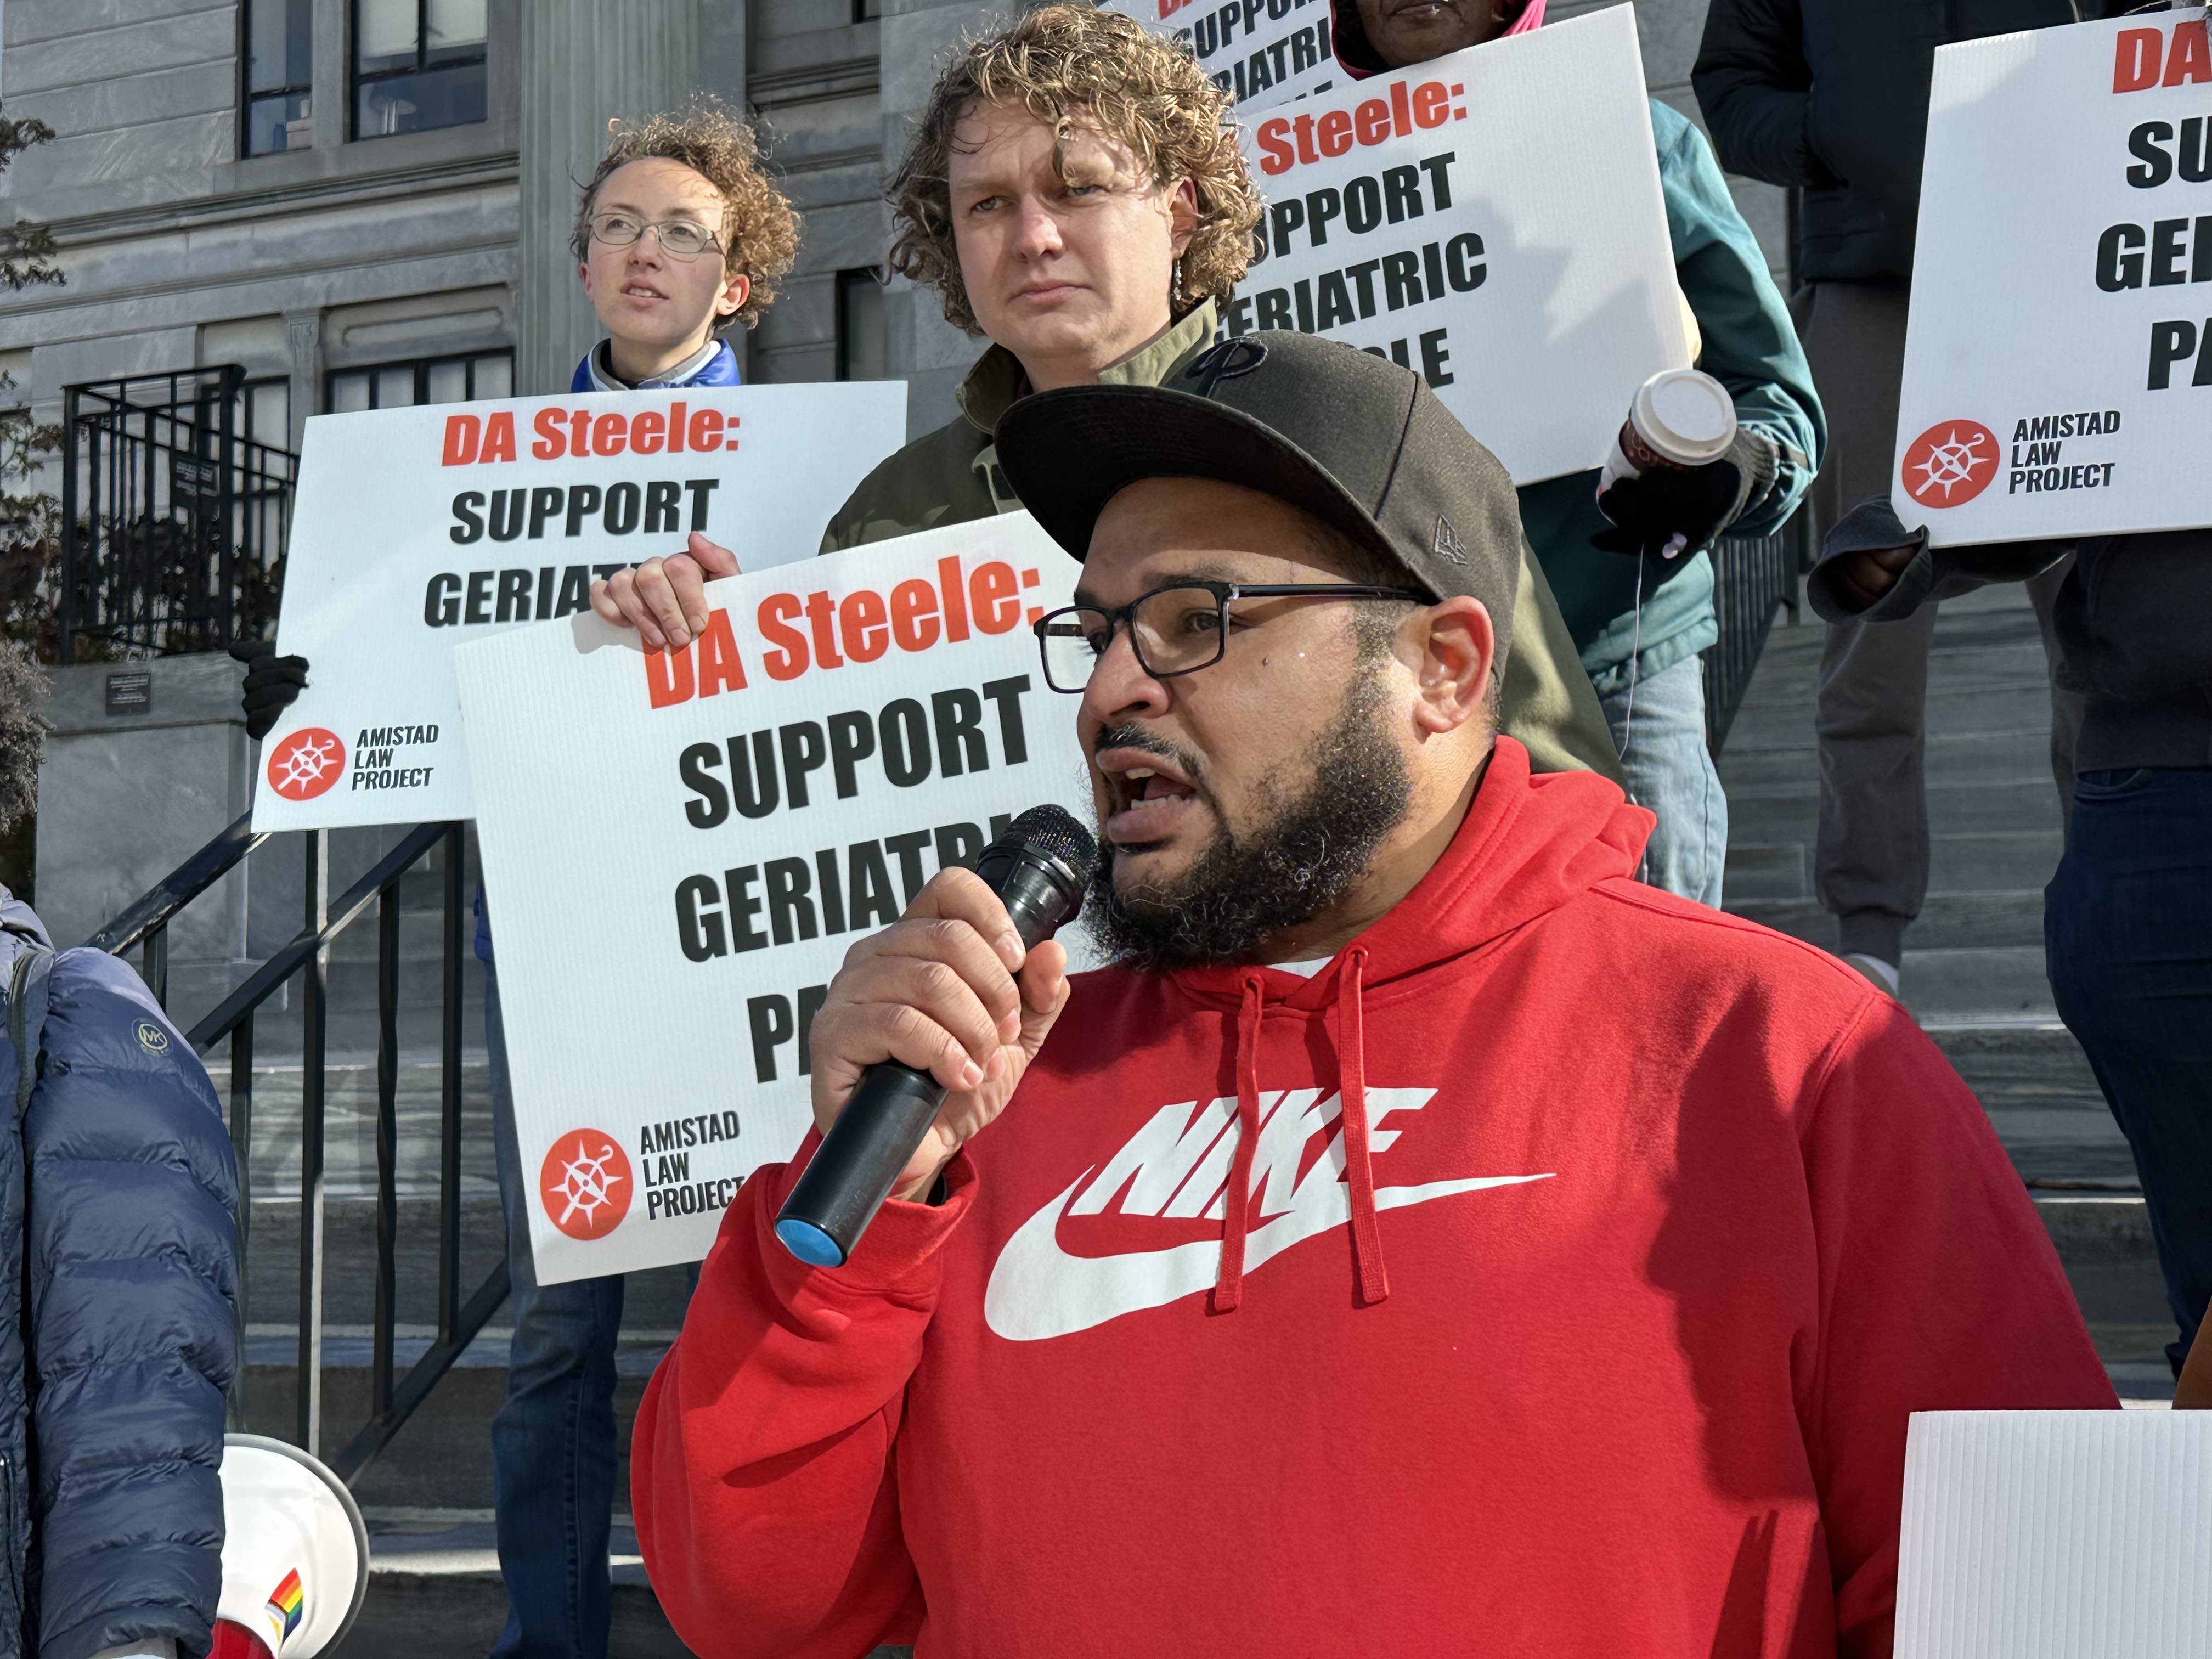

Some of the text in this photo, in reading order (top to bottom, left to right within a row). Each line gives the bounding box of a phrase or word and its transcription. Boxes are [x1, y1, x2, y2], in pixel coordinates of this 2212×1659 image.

[1172, 0, 1317, 59] UPPO
[2112, 19, 2212, 94] DA
[1256, 81, 1467, 176] Steele:
[1214, 233, 1487, 341] ERIATRIC
[442, 402, 740, 467] DA Steele:
[2011, 441, 2062, 468] LAW
[2013, 410, 2120, 442] AMISTAD
[2009, 463, 2115, 494] PROJECT
[449, 479, 719, 544] SUPPORT
[424, 562, 644, 629] GERIA
[640, 555, 1046, 709] DA Steele:
[354, 748, 394, 769] LAW
[357, 725, 439, 748] AMISTAD
[679, 674, 1031, 830] SUPPORT
[352, 767, 434, 791] PROJECT
[675, 812, 1012, 963] GERIAT
[641, 1110, 741, 1155] AMISTAD
[1068, 1087, 1438, 1219] NIKE
[642, 1152, 690, 1188] LAW
